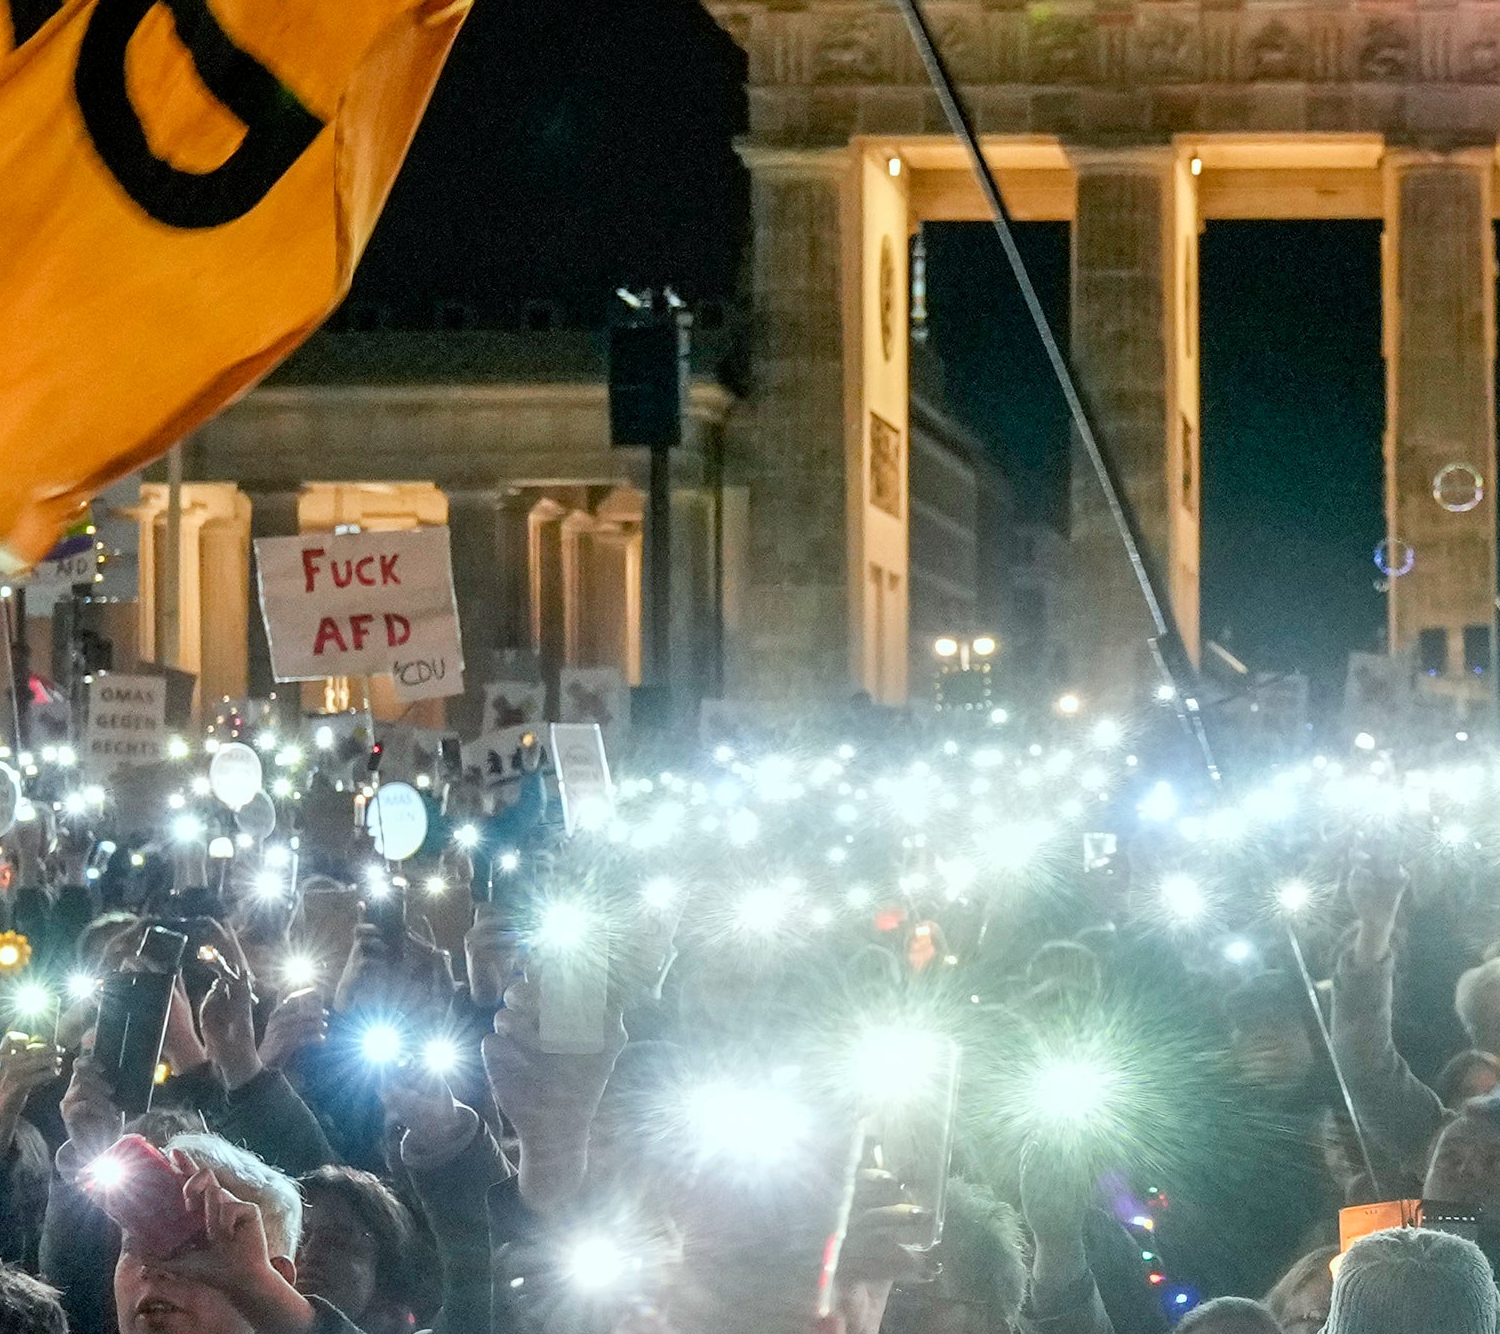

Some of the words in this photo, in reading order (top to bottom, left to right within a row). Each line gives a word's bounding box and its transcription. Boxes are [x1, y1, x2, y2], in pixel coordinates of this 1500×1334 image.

[313, 613, 411, 656] AFD
[100, 687, 154, 705] OMAS
[96, 713, 156, 730] GEGEN
[91, 739, 159, 756] RECHTS
